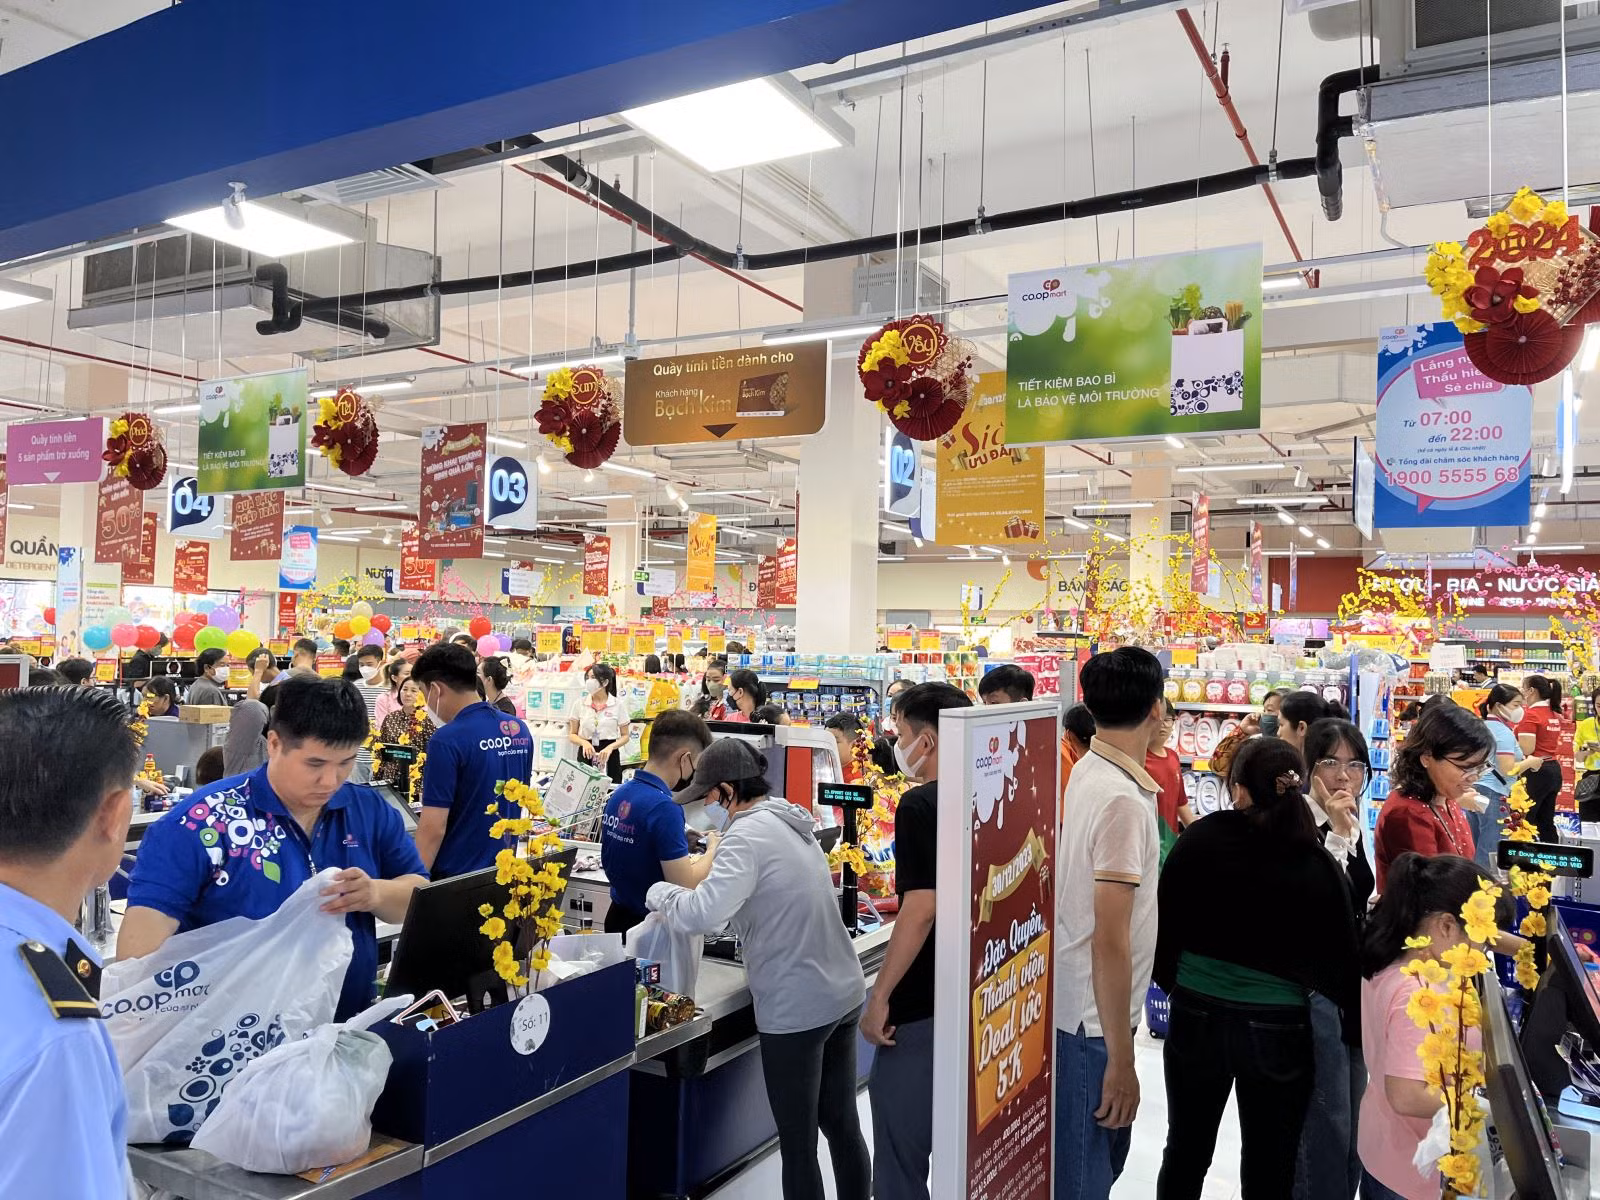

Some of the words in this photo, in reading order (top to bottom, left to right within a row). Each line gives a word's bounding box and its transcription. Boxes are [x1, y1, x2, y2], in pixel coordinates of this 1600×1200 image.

[1468, 215, 1583, 270] 2024
[653, 361, 682, 377] Quầy
[686, 357, 708, 373] tính
[712, 354, 734, 370] tiền
[737, 352, 767, 367] dành
[771, 351, 794, 363] cho
[1420, 359, 1454, 373] Lắng
[572, 380, 597, 395] Sum
[1018, 373, 1042, 391] TIẾT
[1045, 373, 1073, 391] KIỆM
[1076, 375, 1101, 386] BAO
[1105, 371, 1117, 384] BÌ
[1423, 371, 1457, 385] Thấu
[1465, 380, 1493, 392] chia
[656, 388, 678, 398] Khách
[679, 386, 698, 399] hàng
[1018, 391, 1032, 408] LÀ
[1061, 389, 1077, 406] VỆ
[1079, 388, 1101, 403] MÔI
[1105, 385, 1160, 402] TRƯỜNG
[655, 398, 696, 420] Bạch
[699, 389, 732, 414] Kim
[1403, 418, 1417, 429] Từ
[1420, 410, 1472, 427] 07:00
[31, 432, 48, 446] Quầy
[1428, 432, 1447, 444] đến
[1450, 425, 1503, 443] 22:00
[18, 453, 24, 463] 5
[968, 453, 989, 469] ƯU
[1473, 454, 1499, 463] khách
[1385, 470, 1432, 486] 1900
[1439, 468, 1487, 484] 5555
[1494, 466, 1520, 482] 68
[492, 470, 526, 504] 03
[174, 487, 212, 518] 04
[101, 501, 141, 539] 50%
[10, 535, 58, 558] QUẦN
[1447, 577, 1480, 592] BIA
[1498, 573, 1560, 592] NƯỚC
[992, 845, 1033, 898] 30/12/2023
[984, 939, 1007, 977] Đặc
[1009, 903, 1043, 952] Quyền
[980, 963, 1018, 1021] Thành
[521, 1015, 537, 1032] Số:
[538, 1013, 548, 1028] 11
[978, 999, 1017, 1071] Deal
[997, 1041, 1023, 1100] 5K
